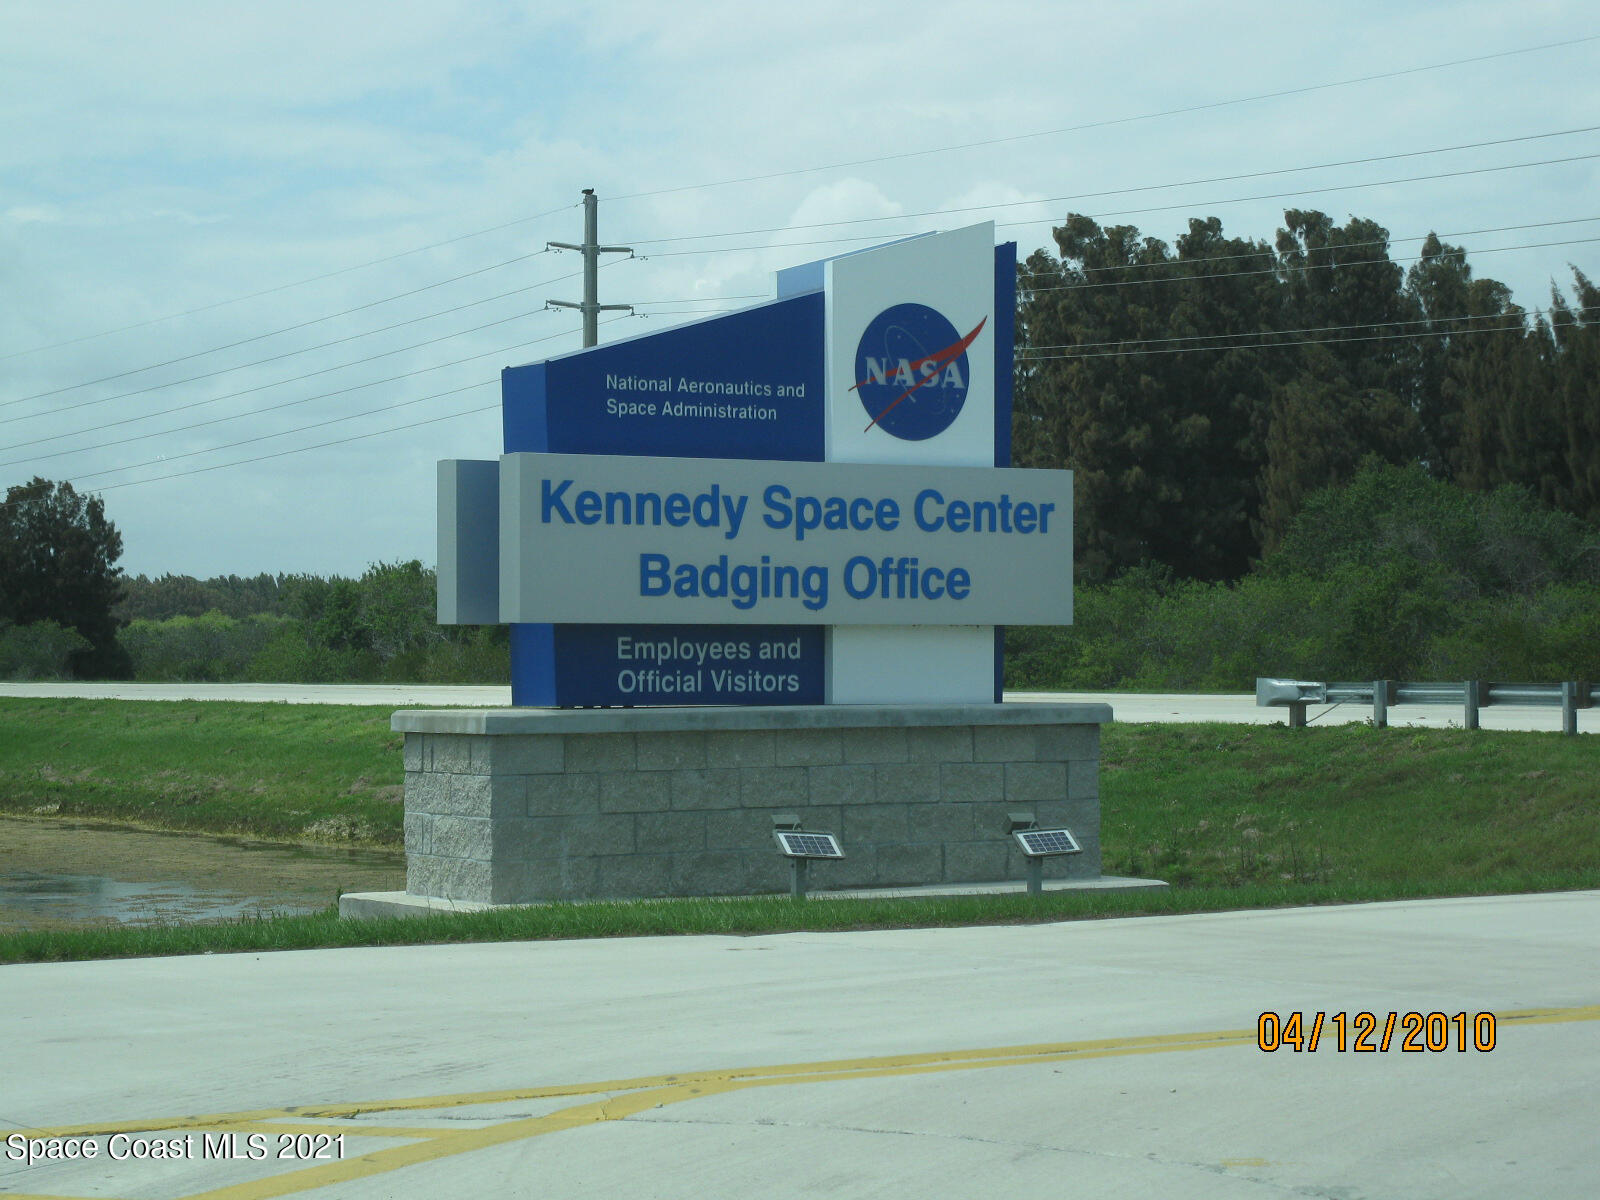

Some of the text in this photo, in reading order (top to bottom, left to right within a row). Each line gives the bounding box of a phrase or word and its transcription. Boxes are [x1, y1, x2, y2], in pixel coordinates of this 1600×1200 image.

[606, 374, 806, 398] National Aeronautics and
[864, 356, 966, 389] NASA
[606, 398, 778, 421] Space Administration
[541, 479, 1055, 541] Kennedy Space Center
[640, 553, 971, 611] Badging Office
[617, 636, 802, 666] Employees and
[617, 669, 800, 694] Official Visitors
